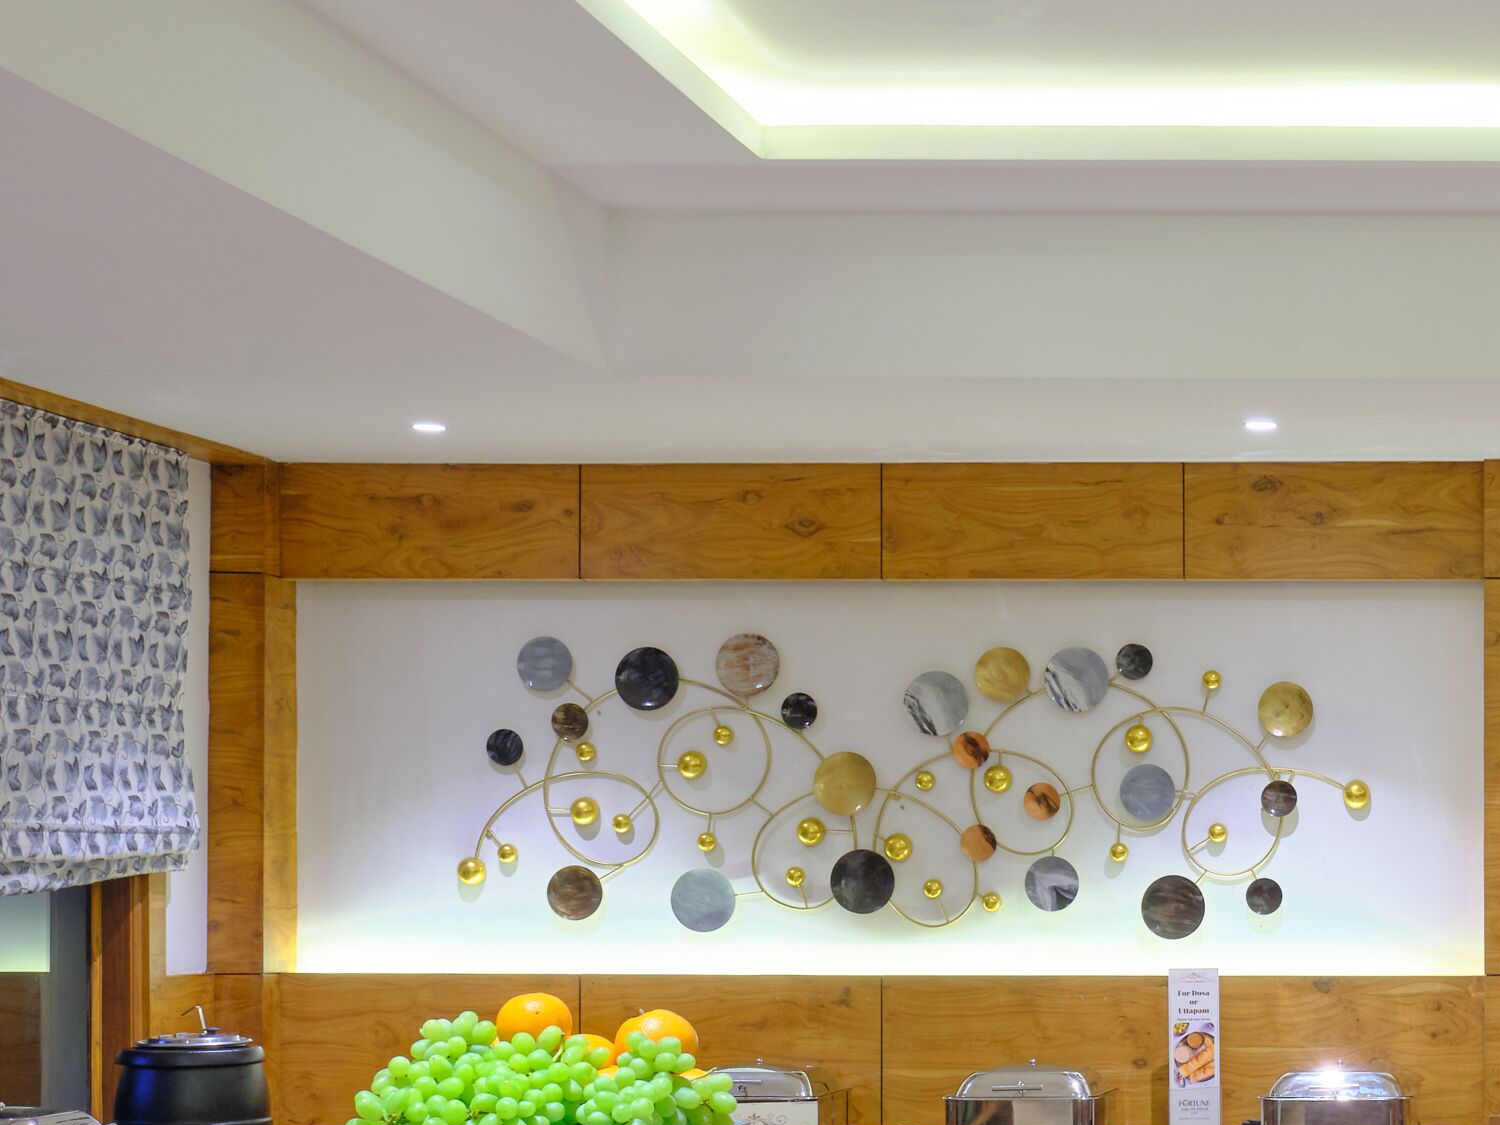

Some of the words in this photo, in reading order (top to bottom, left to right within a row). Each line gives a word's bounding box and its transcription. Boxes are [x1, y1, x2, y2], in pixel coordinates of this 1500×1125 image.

[1177, 989, 1191, 997] For
[1191, 989, 1210, 997] Dosa
[1178, 1007, 1210, 1015] Uttapam
[1178, 1099, 1211, 1108] FORTUNE
